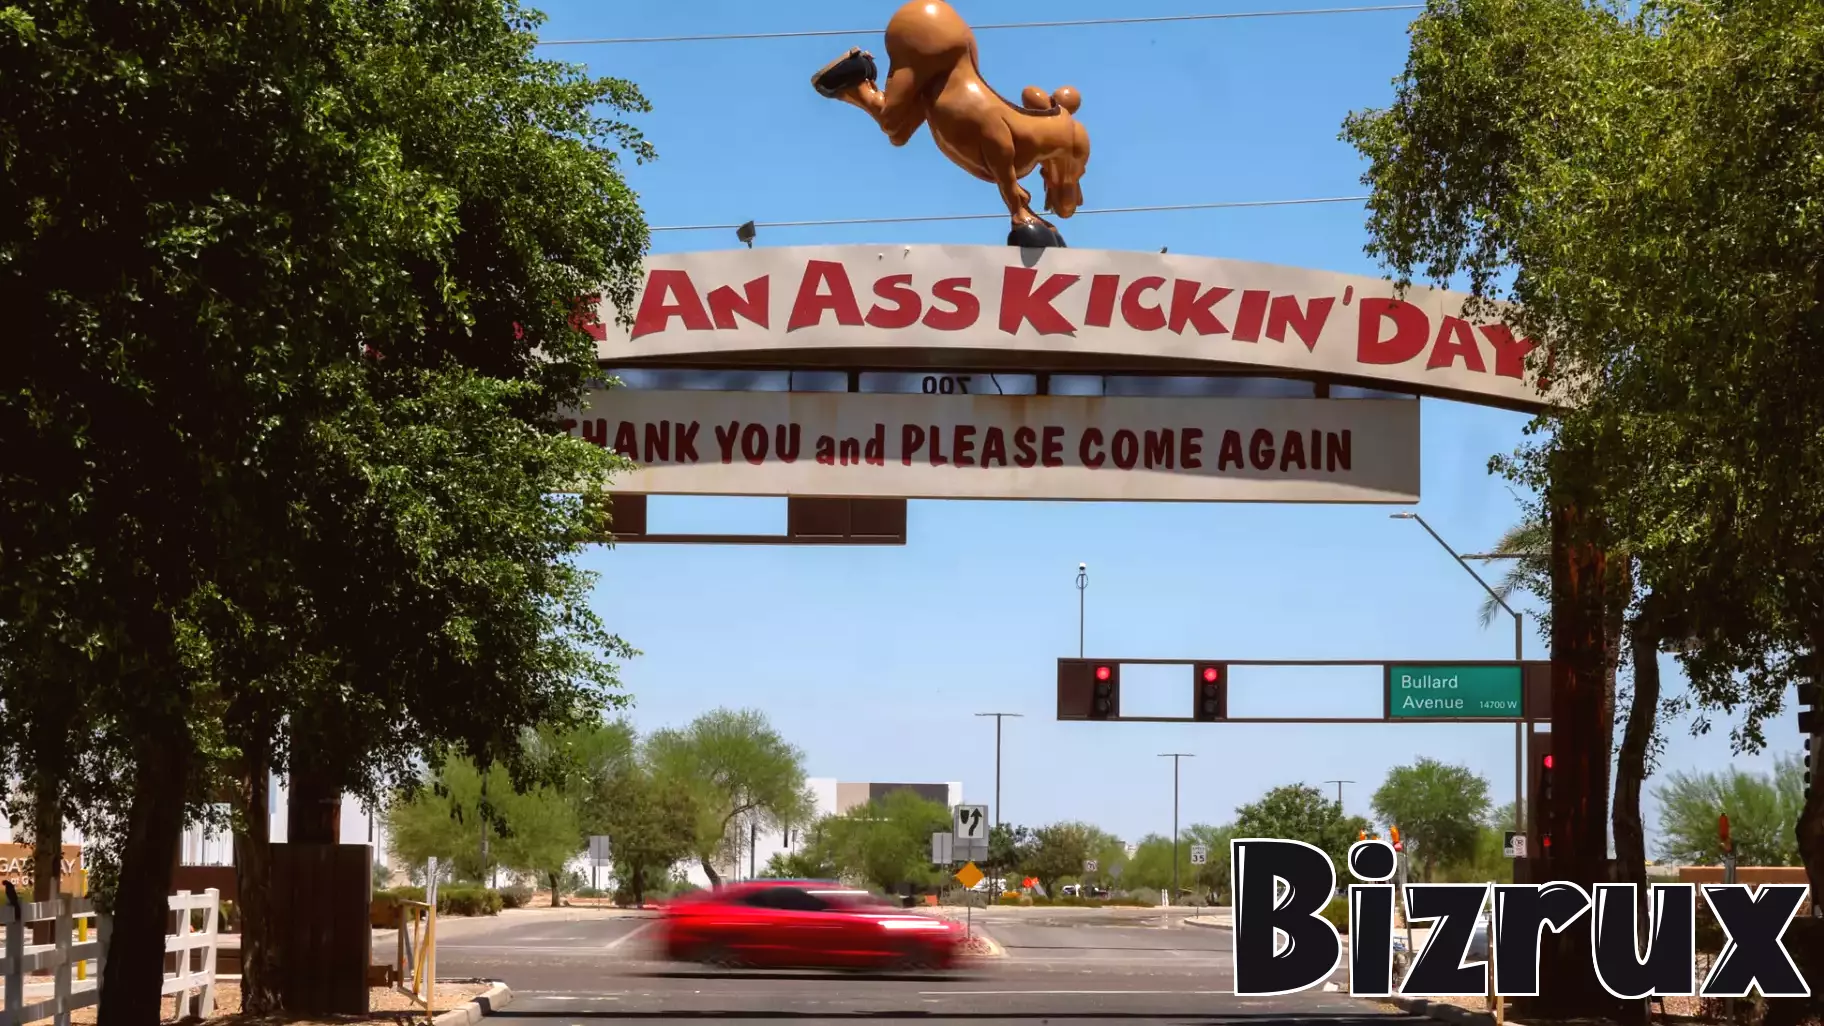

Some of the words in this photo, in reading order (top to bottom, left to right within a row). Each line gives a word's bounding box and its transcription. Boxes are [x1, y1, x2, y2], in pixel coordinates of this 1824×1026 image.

[787, 259, 980, 332] ASS
[714, 421, 801, 466] YOU
[815, 423, 885, 467] and
[901, 424, 1064, 469] PLEASE
[1078, 427, 1203, 470] COME
[1217, 429, 1352, 472] AGAIN
[1401, 674, 1458, 689] Bullard
[1402, 695, 1464, 709] Avenue
[1479, 701, 1506, 709] 14700
[1507, 701, 1518, 709] W
